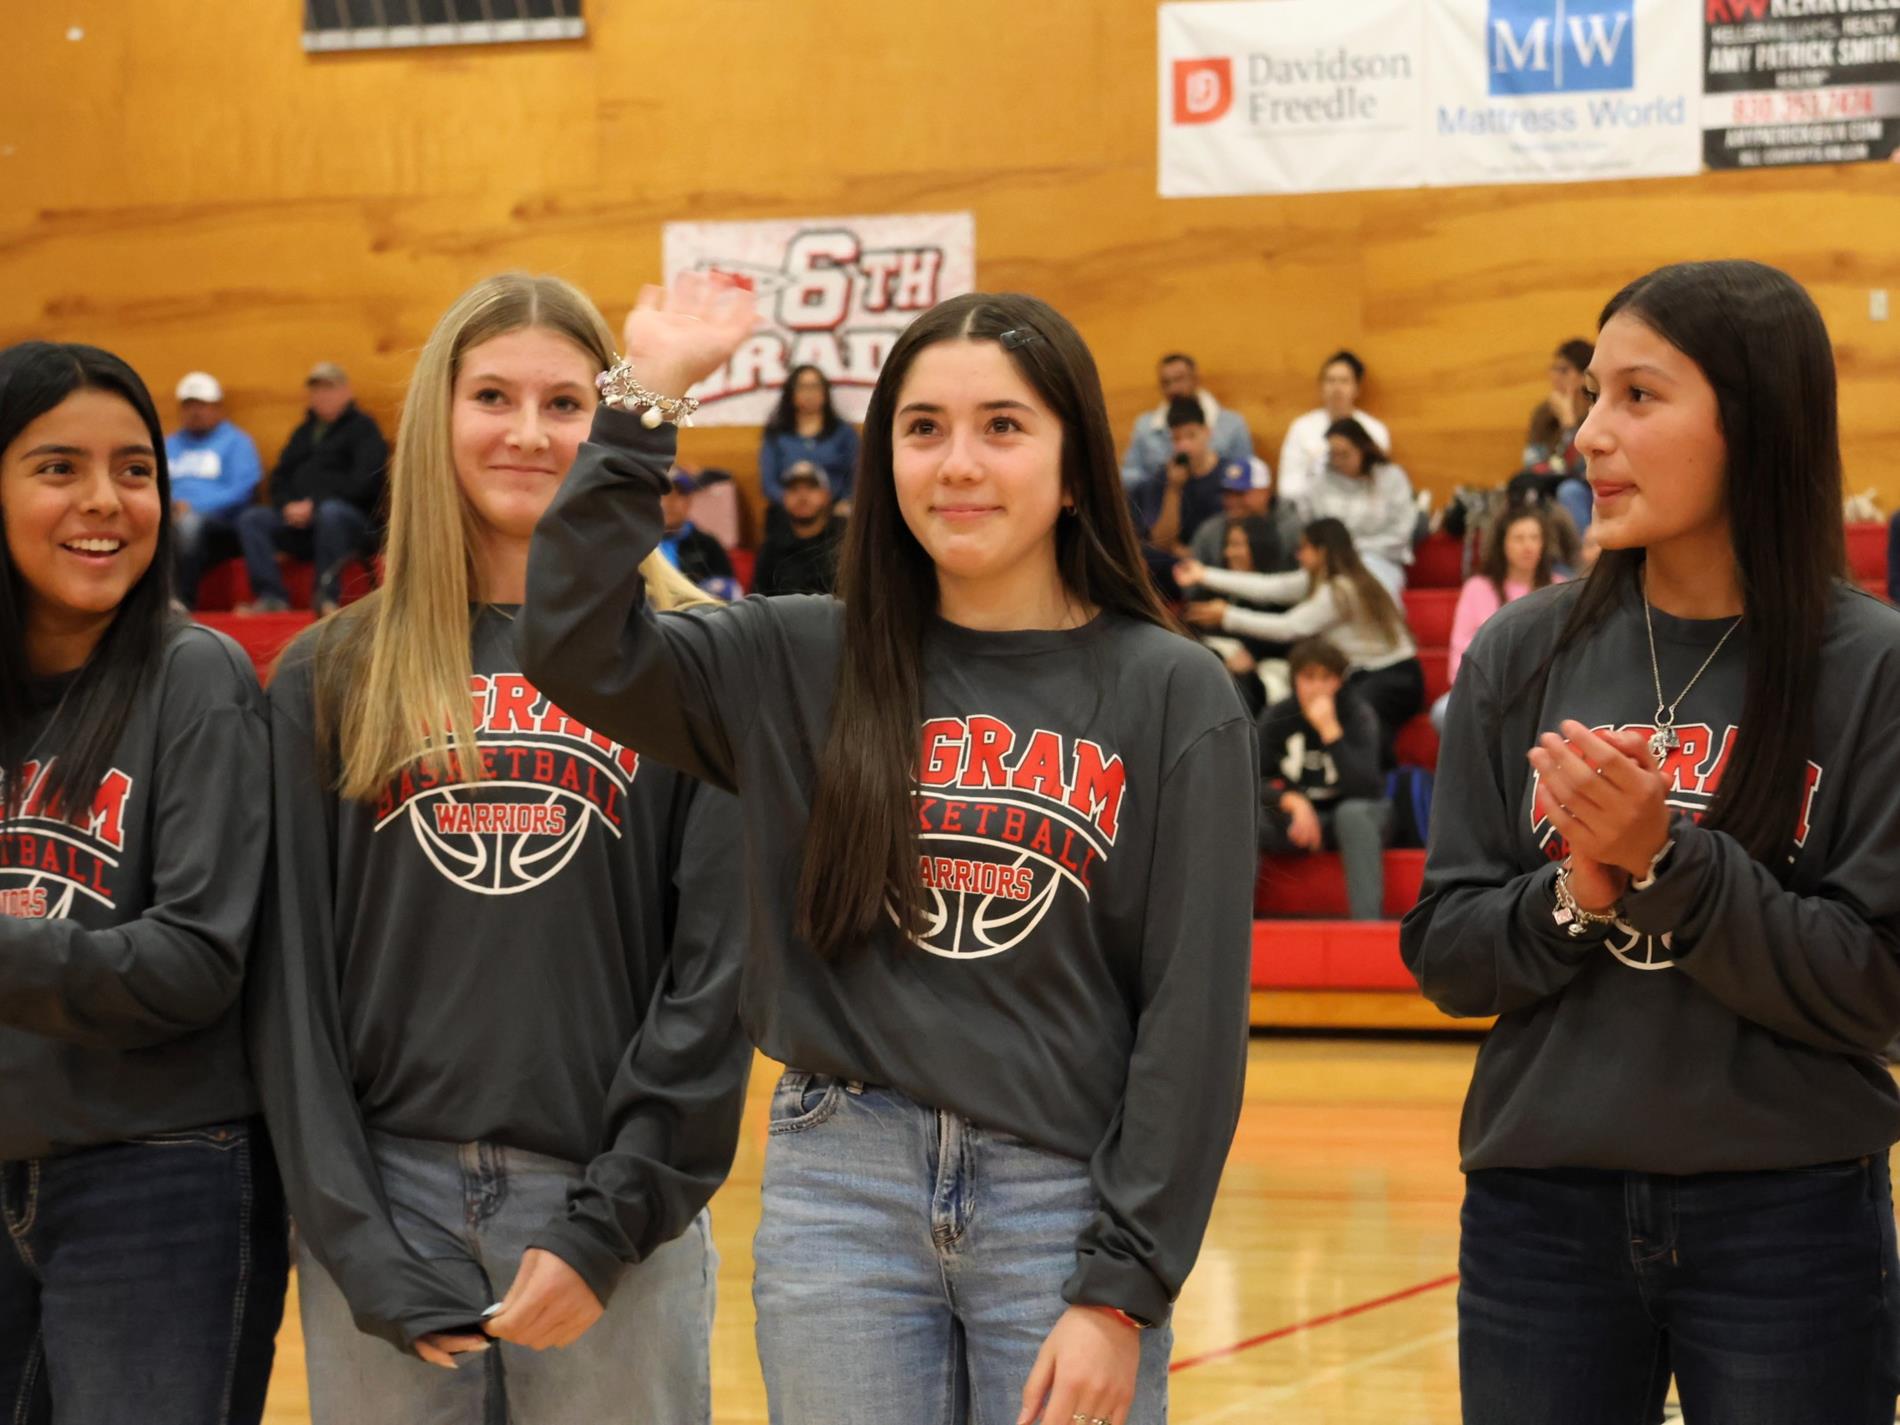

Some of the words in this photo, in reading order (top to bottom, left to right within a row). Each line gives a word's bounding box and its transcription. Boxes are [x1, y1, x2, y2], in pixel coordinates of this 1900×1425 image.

[1248, 47, 1413, 86] Davidson
[1709, 47, 1751, 73] AMY
[1755, 40, 1835, 71] PATRICK
[1837, 35, 1900, 65] SMITH
[1248, 86, 1379, 126] Freedle
[1436, 104, 1578, 136] Mattress
[1587, 95, 1687, 129] World
[697, 327, 902, 404] RAD
[910, 713, 1127, 847] GRAM
[432, 803, 567, 836] WARRIORS
[912, 798, 1097, 890] KETBALL
[917, 855, 1034, 902] ARRIORS
